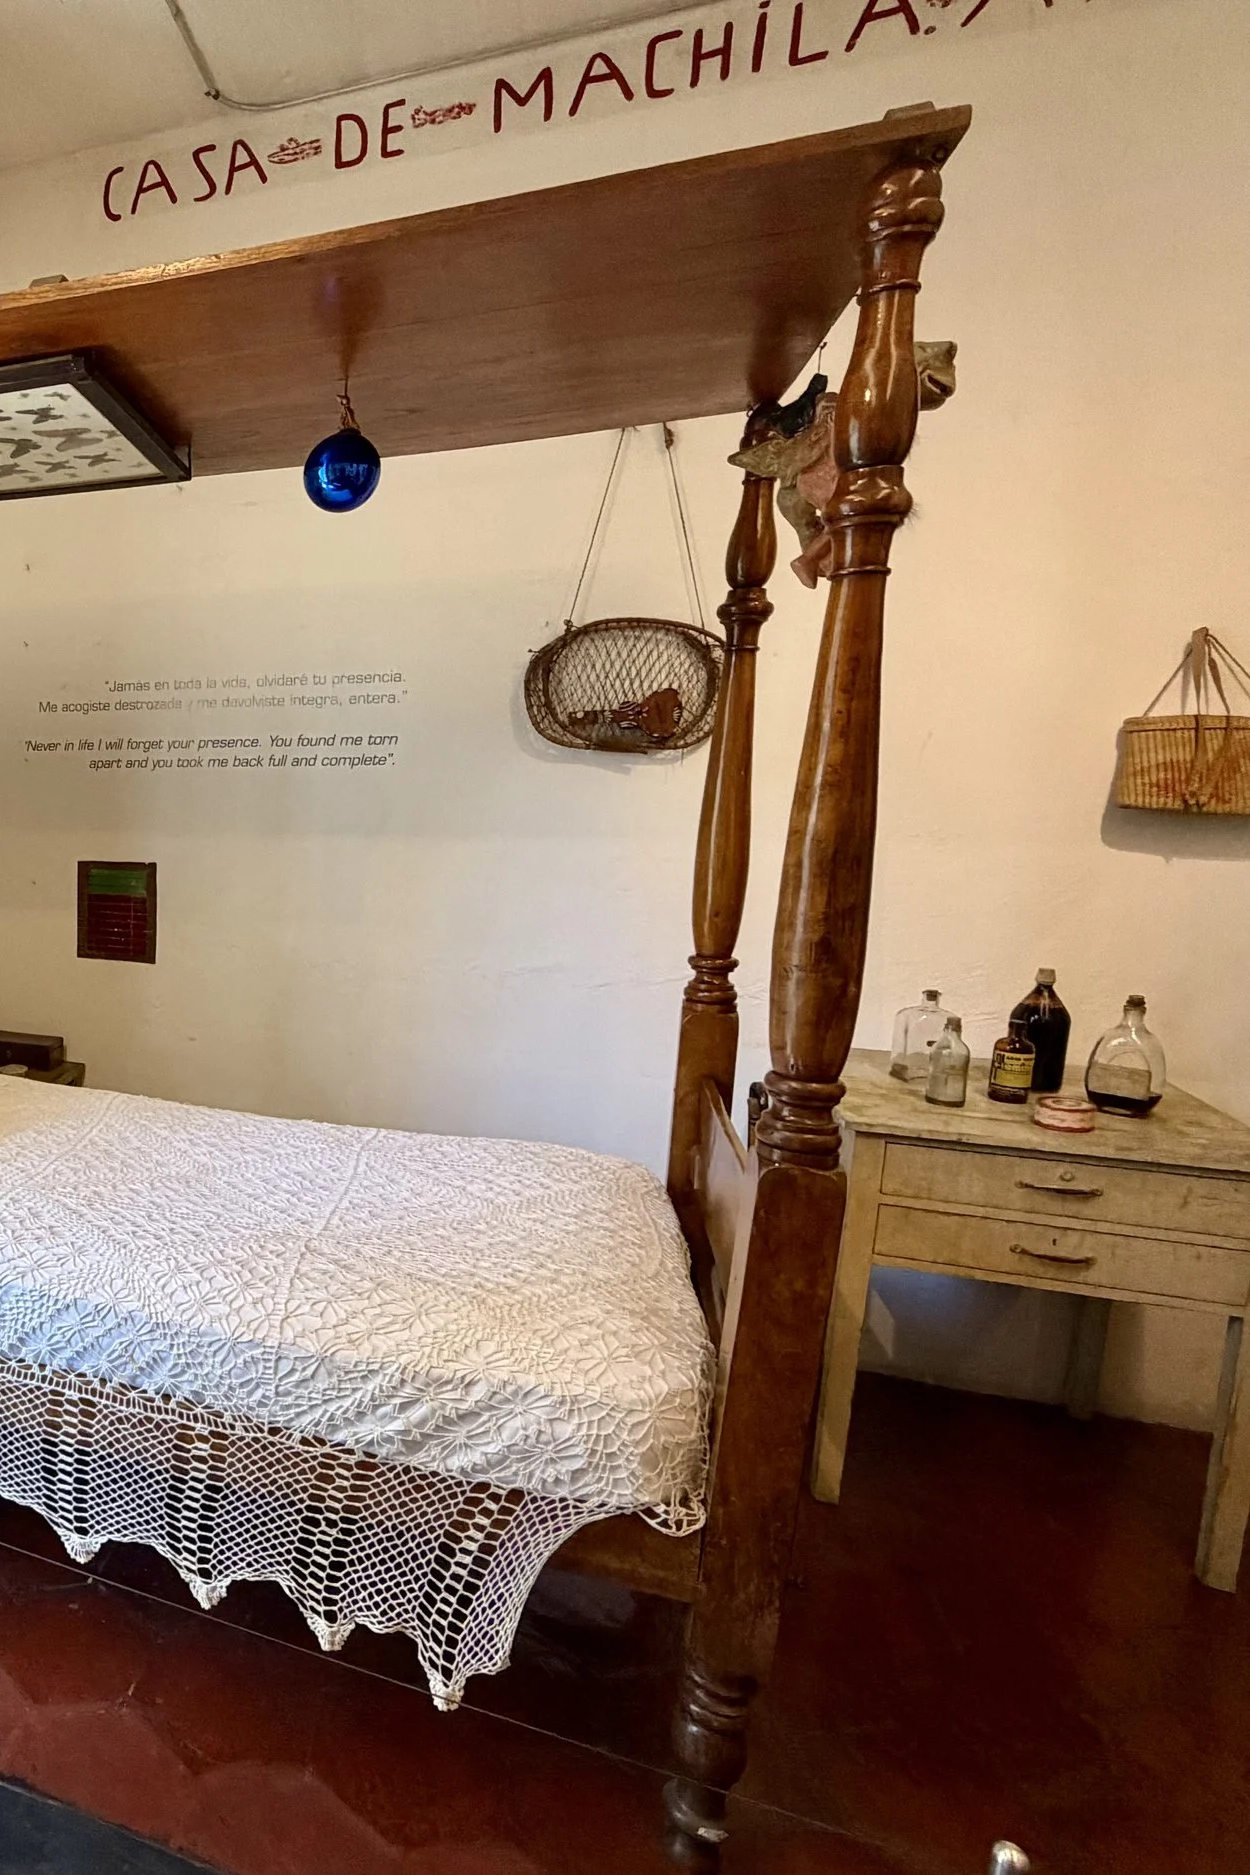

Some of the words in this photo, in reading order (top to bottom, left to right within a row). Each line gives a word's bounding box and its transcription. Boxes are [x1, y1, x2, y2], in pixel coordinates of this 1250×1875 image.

[102, 138, 268, 222] CASA
[334, 98, 407, 170] DE
[154, 680, 170, 691] en
[173, 678, 202, 691] toda
[206, 677, 217, 689] la
[256, 673, 308, 688] olvidaré
[313, 674, 327, 686] tu
[331, 670, 406, 688] presencia.
[38, 701, 58, 713] Me
[61, 700, 111, 715] acogiste
[114, 697, 183, 712] destrozada
[64, 739, 75, 751] in
[78, 738, 94, 751] life
[105, 738, 124, 750] will
[126, 737, 164, 753] forget
[167, 739, 195, 753] your
[197, 737, 262, 752] presence.
[269, 734, 293, 748] You
[297, 733, 336, 747] found
[340, 735, 363, 746] me
[367, 734, 399, 746] torn
[88, 757, 123, 771] apart
[125, 756, 149, 769] and
[150, 758, 173, 771] you
[177, 755, 204, 768] took
[207, 756, 229, 767] me
[232, 755, 265, 768] back
[268, 754, 288, 767] full
[291, 754, 318, 767] and
